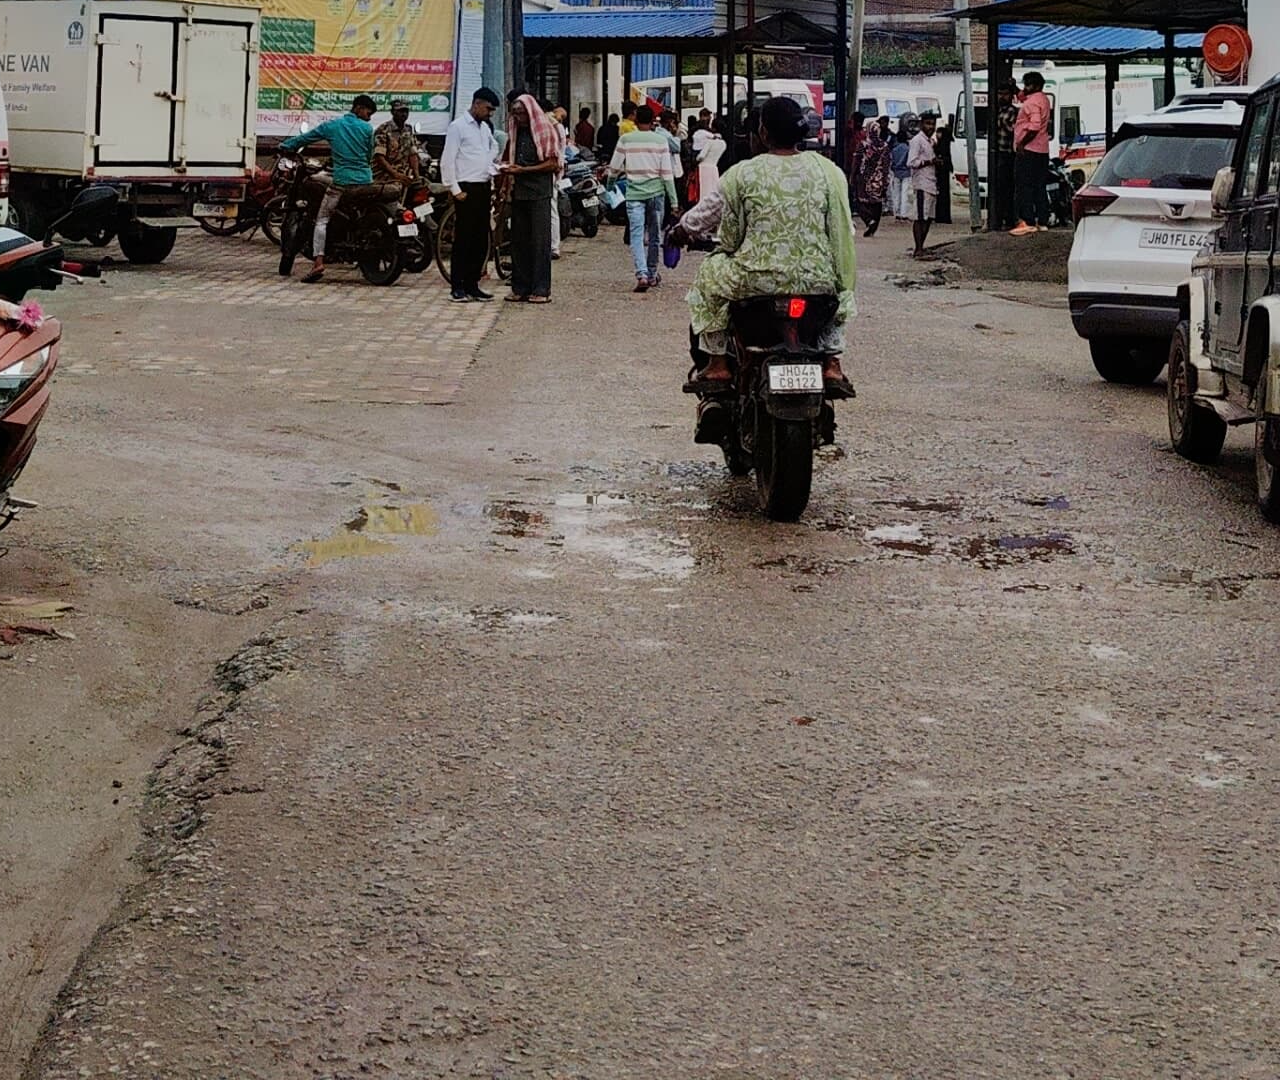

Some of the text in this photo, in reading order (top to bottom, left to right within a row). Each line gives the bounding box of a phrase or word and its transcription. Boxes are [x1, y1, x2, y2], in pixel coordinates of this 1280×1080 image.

[20, 54, 51, 73] VAN
[1147, 230, 1210, 248] JH01FL642
[778, 365, 817, 377] JH04A
